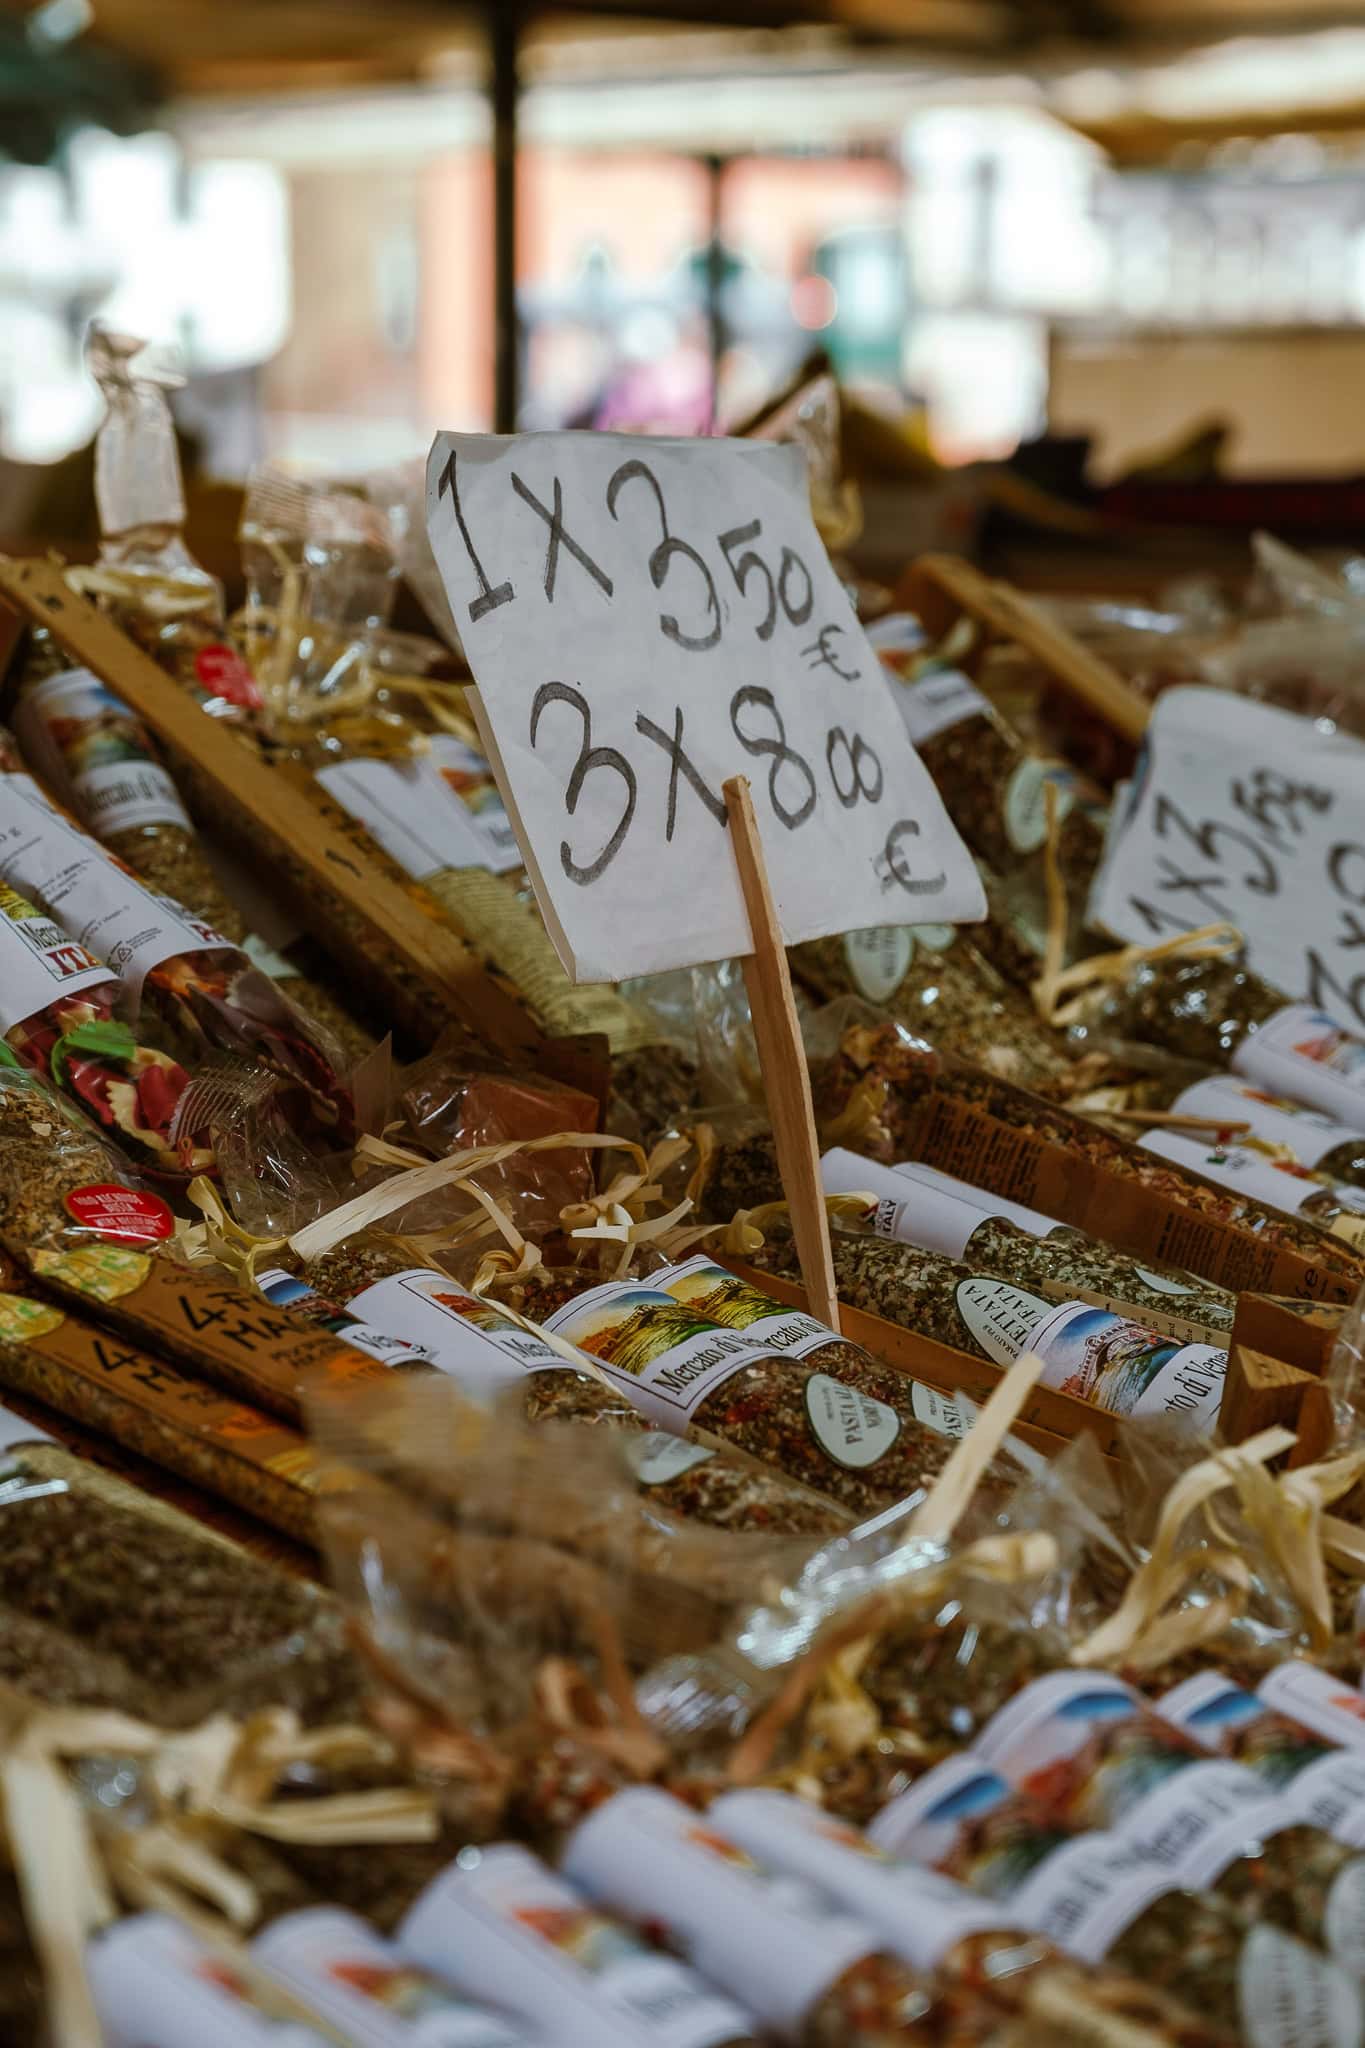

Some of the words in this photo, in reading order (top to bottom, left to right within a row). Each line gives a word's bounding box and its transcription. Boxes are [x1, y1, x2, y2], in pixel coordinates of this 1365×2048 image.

[438, 449, 514, 623] 1
[800, 623, 862, 682] €
[529, 680, 638, 887] 3
[870, 819, 948, 896] €
[964, 1285, 1027, 1348] ETTATA
[994, 1286, 1044, 1329] UFATA
[652, 1348, 727, 1396] Mercato
[1173, 1369, 1213, 1399] di
